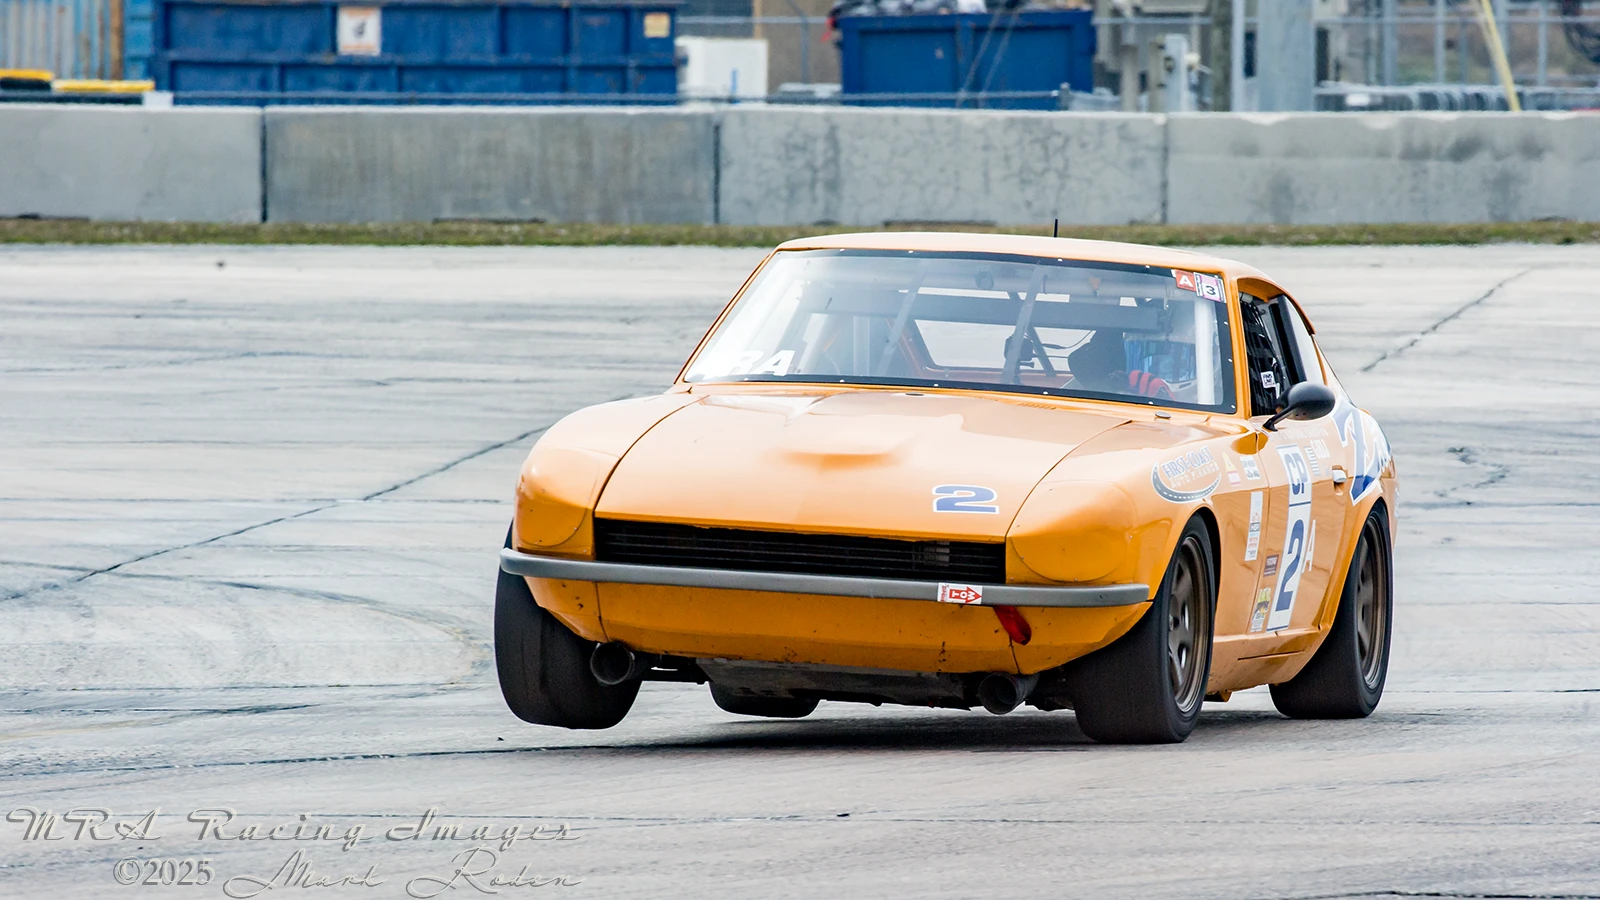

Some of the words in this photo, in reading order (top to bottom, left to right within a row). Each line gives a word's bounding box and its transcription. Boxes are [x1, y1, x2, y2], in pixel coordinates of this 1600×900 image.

[1179, 275, 1194, 288] A
[1205, 285, 1216, 296] 3
[932, 484, 999, 514] 2
[952, 590, 976, 600] TOW
